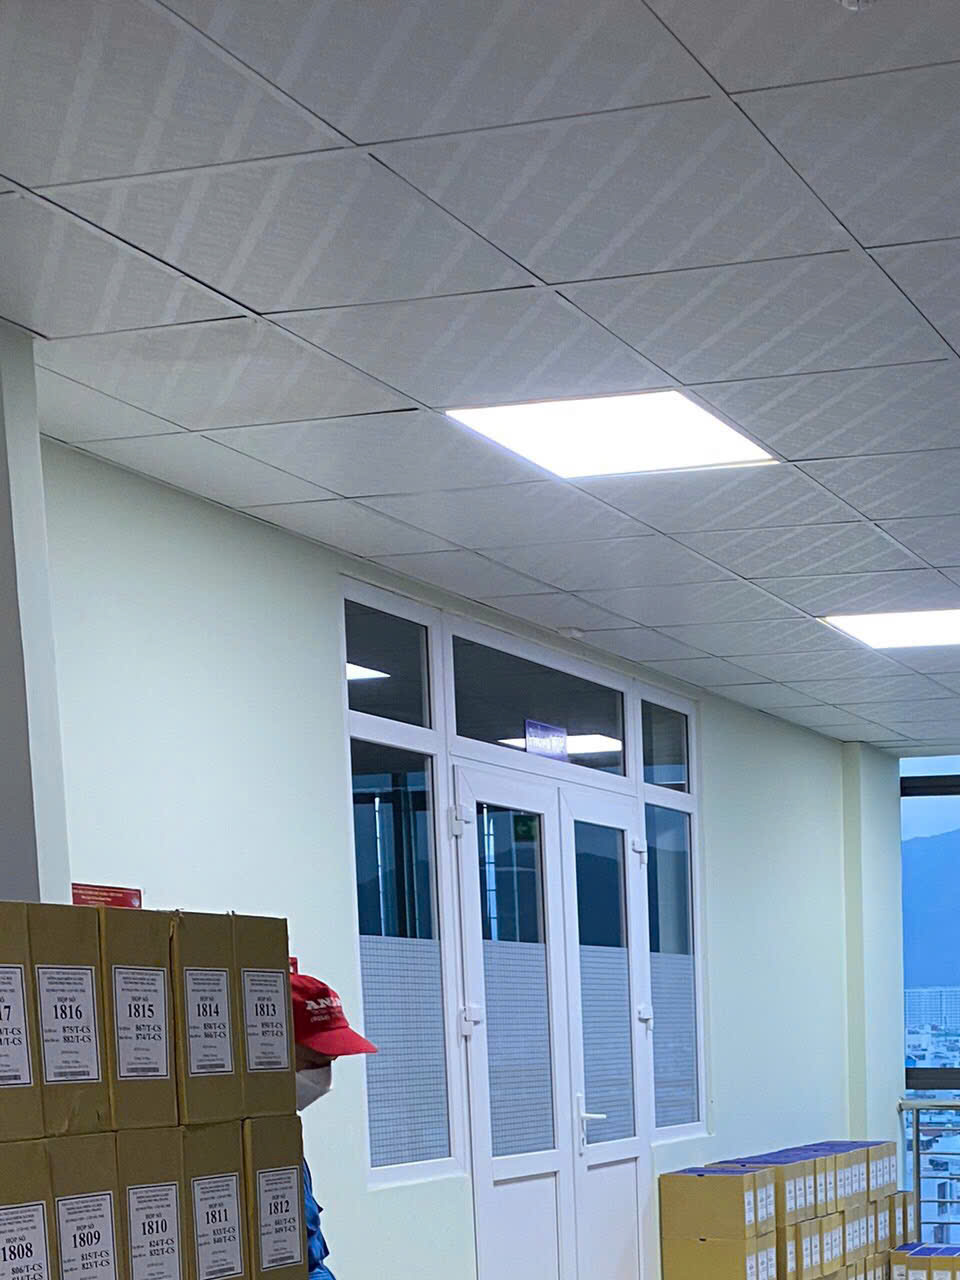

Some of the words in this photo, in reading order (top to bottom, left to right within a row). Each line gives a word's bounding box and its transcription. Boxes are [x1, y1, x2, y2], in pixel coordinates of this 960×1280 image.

[54, 1004, 82, 1020] 1816
[128, 1004, 154, 1018] 1815
[196, 1004, 220, 1016] 1814
[254, 1004, 276, 1016] 1813
[62, 1026, 90, 1034] 875/T-CS
[268, 1200, 290, 1215] 1812
[206, 1208, 228, 1224] 1811
[142, 1219, 167, 1236] 1810
[72, 1230, 100, 1248] 1809
[1, 1242, 33, 1262] 1808
[82, 1260, 110, 1270] 823/T-CS
